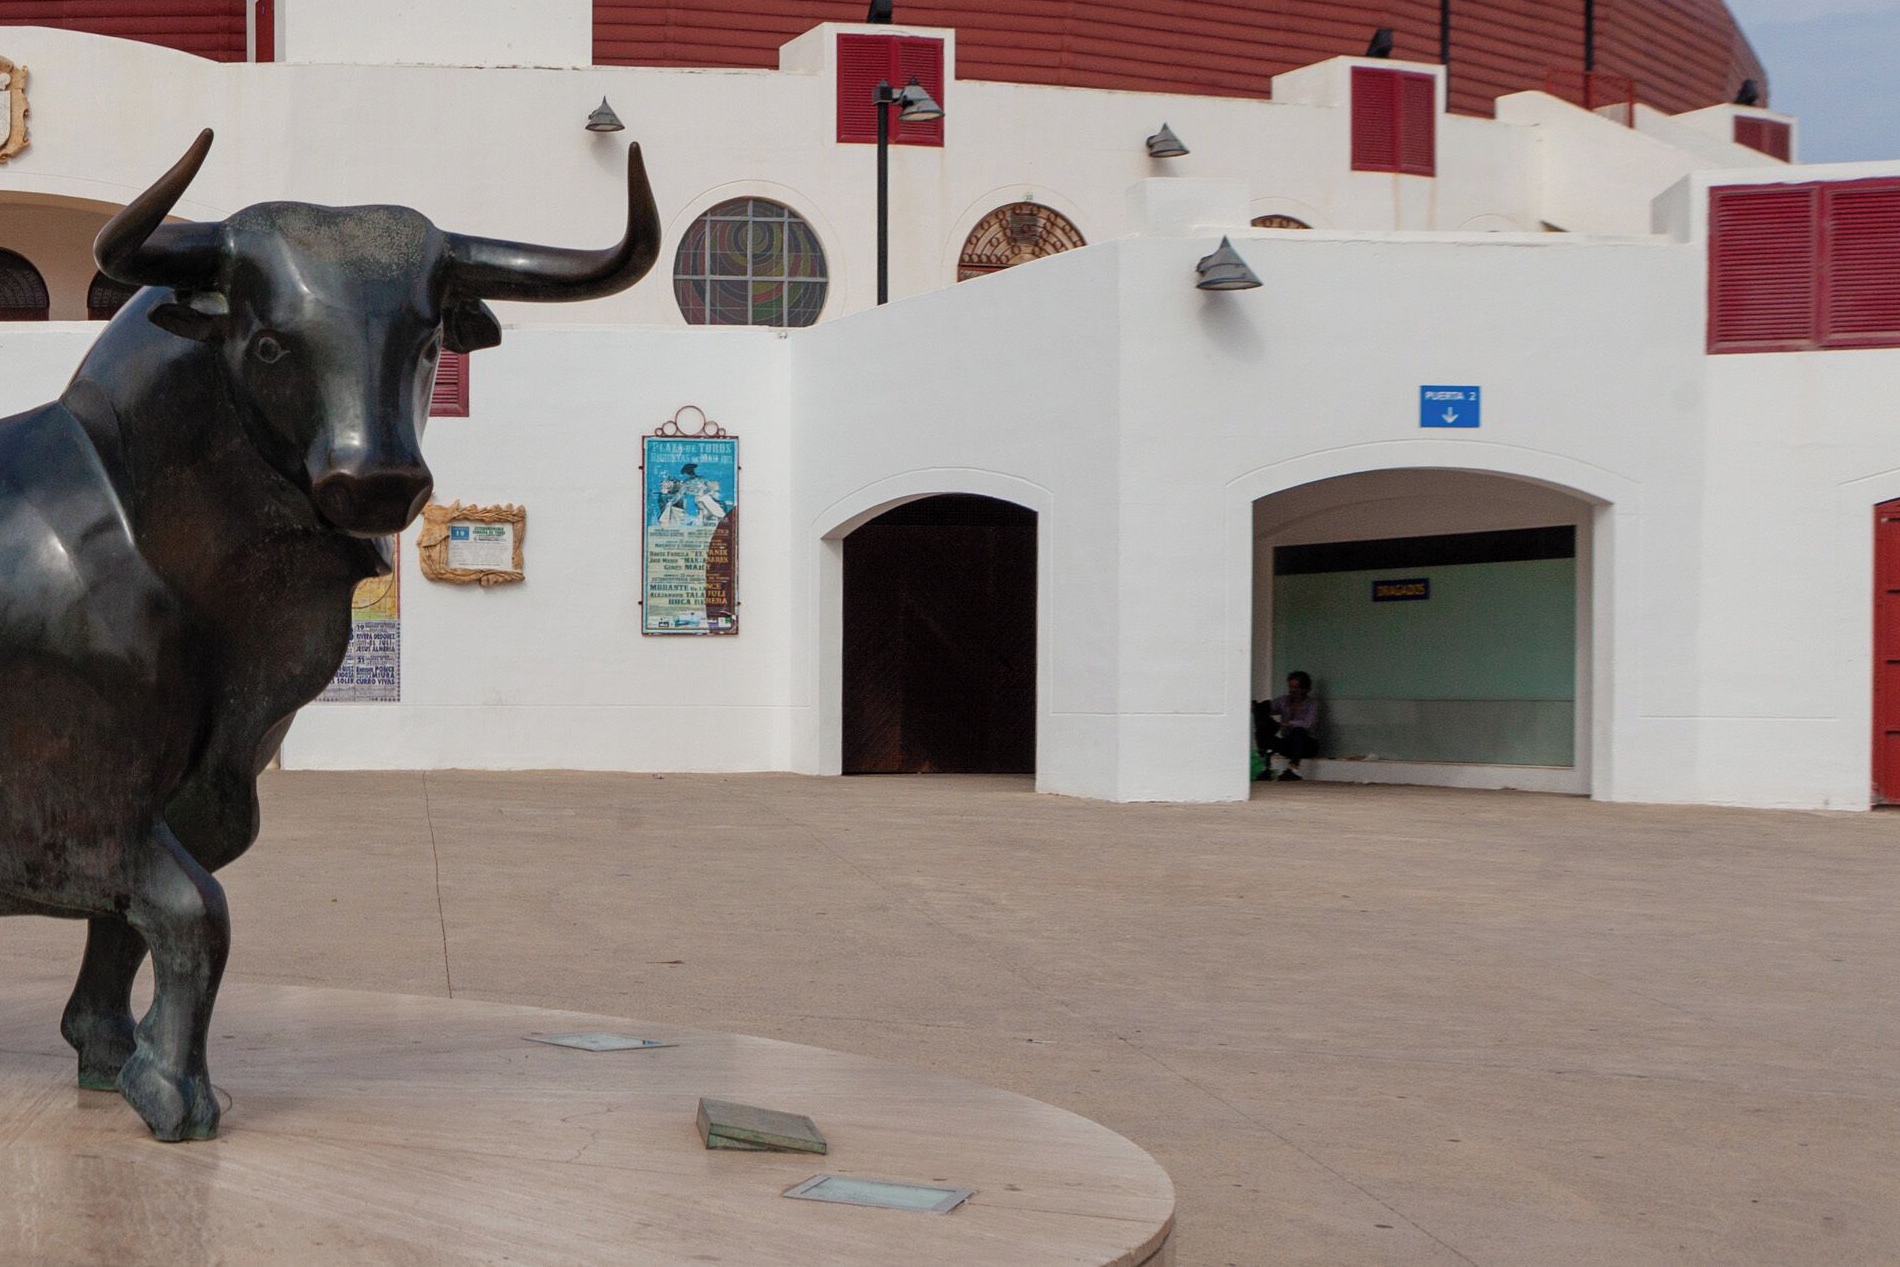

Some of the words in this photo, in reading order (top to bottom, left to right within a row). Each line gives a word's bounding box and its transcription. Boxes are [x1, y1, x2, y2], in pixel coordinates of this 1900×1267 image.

[1425, 391, 1464, 401] PUERTA
[1468, 391, 1477, 401] 2
[698, 443, 732, 454] TOROS
